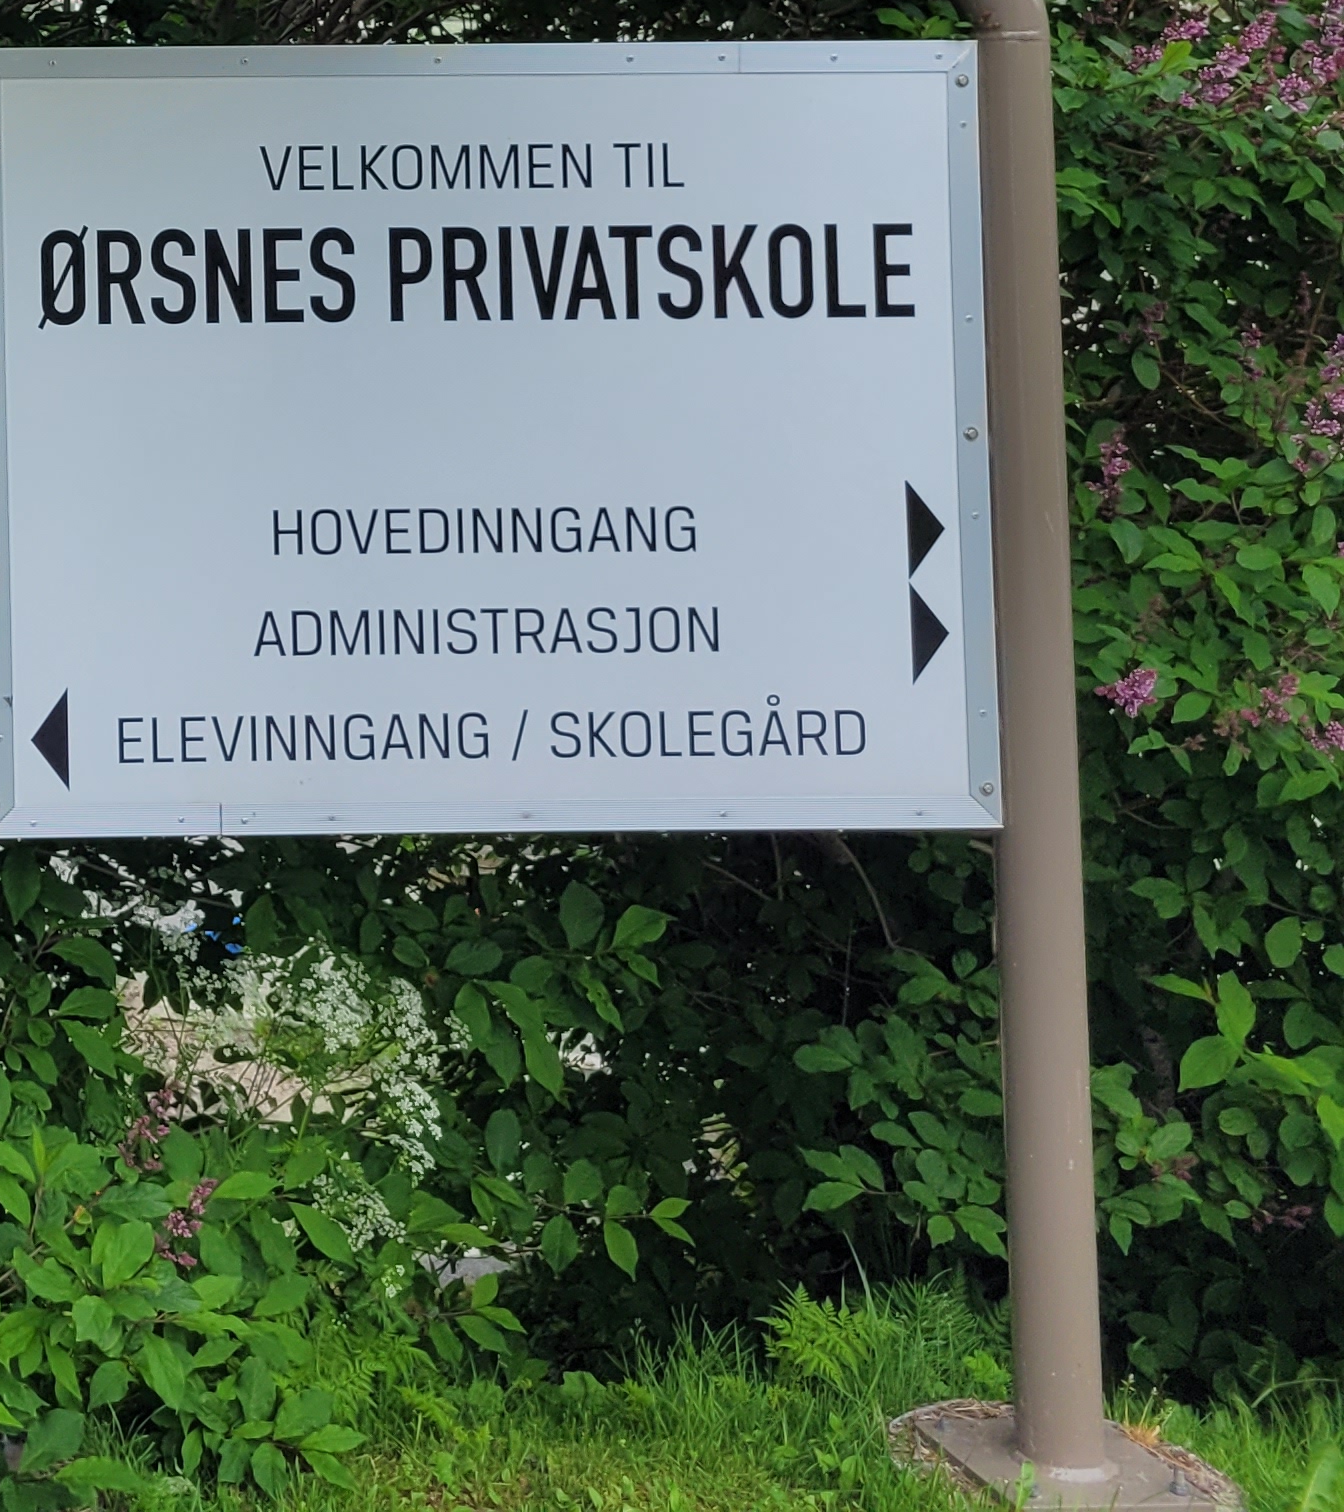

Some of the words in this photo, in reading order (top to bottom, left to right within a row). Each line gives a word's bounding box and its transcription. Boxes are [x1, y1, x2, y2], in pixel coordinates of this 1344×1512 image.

[259, 144, 593, 191] VELKOMMEN
[612, 142, 685, 188] TIL
[38, 225, 356, 329] ØRSNES
[388, 223, 916, 322] PRIVATSKOLE
[272, 506, 697, 555] HOVEDINNGANG
[253, 607, 720, 656] ADMINISTRASJON
[117, 712, 490, 763] ELEVINNGANG
[511, 710, 529, 762] /
[550, 695, 866, 758] SKOLEGÅRD
